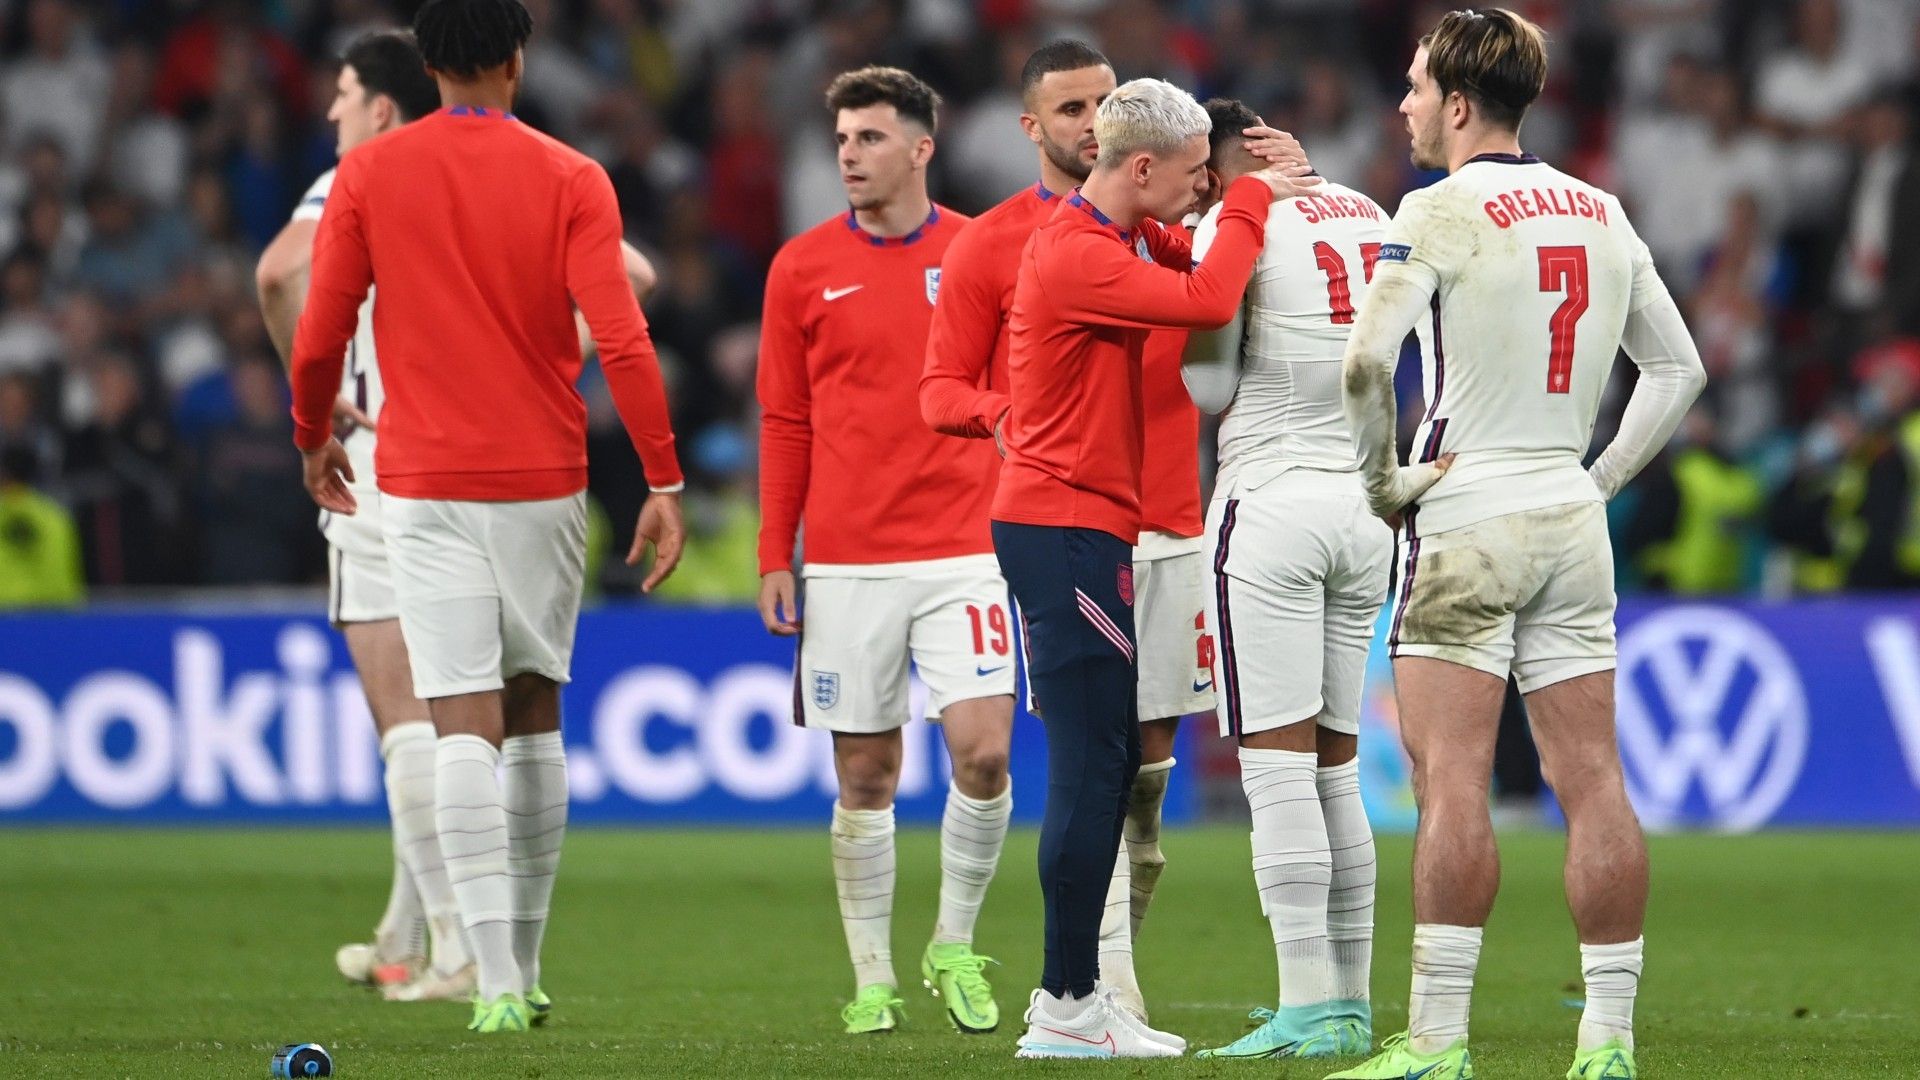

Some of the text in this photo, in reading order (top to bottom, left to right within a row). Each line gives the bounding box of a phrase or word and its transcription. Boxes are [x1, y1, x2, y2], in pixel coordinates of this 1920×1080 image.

[1295, 194, 1380, 223] SANCHO
[1484, 188, 1608, 229] GREALISH
[1378, 247, 1410, 257] ESPECT
[1536, 245, 1589, 394] 7
[966, 603, 1009, 656] 19
